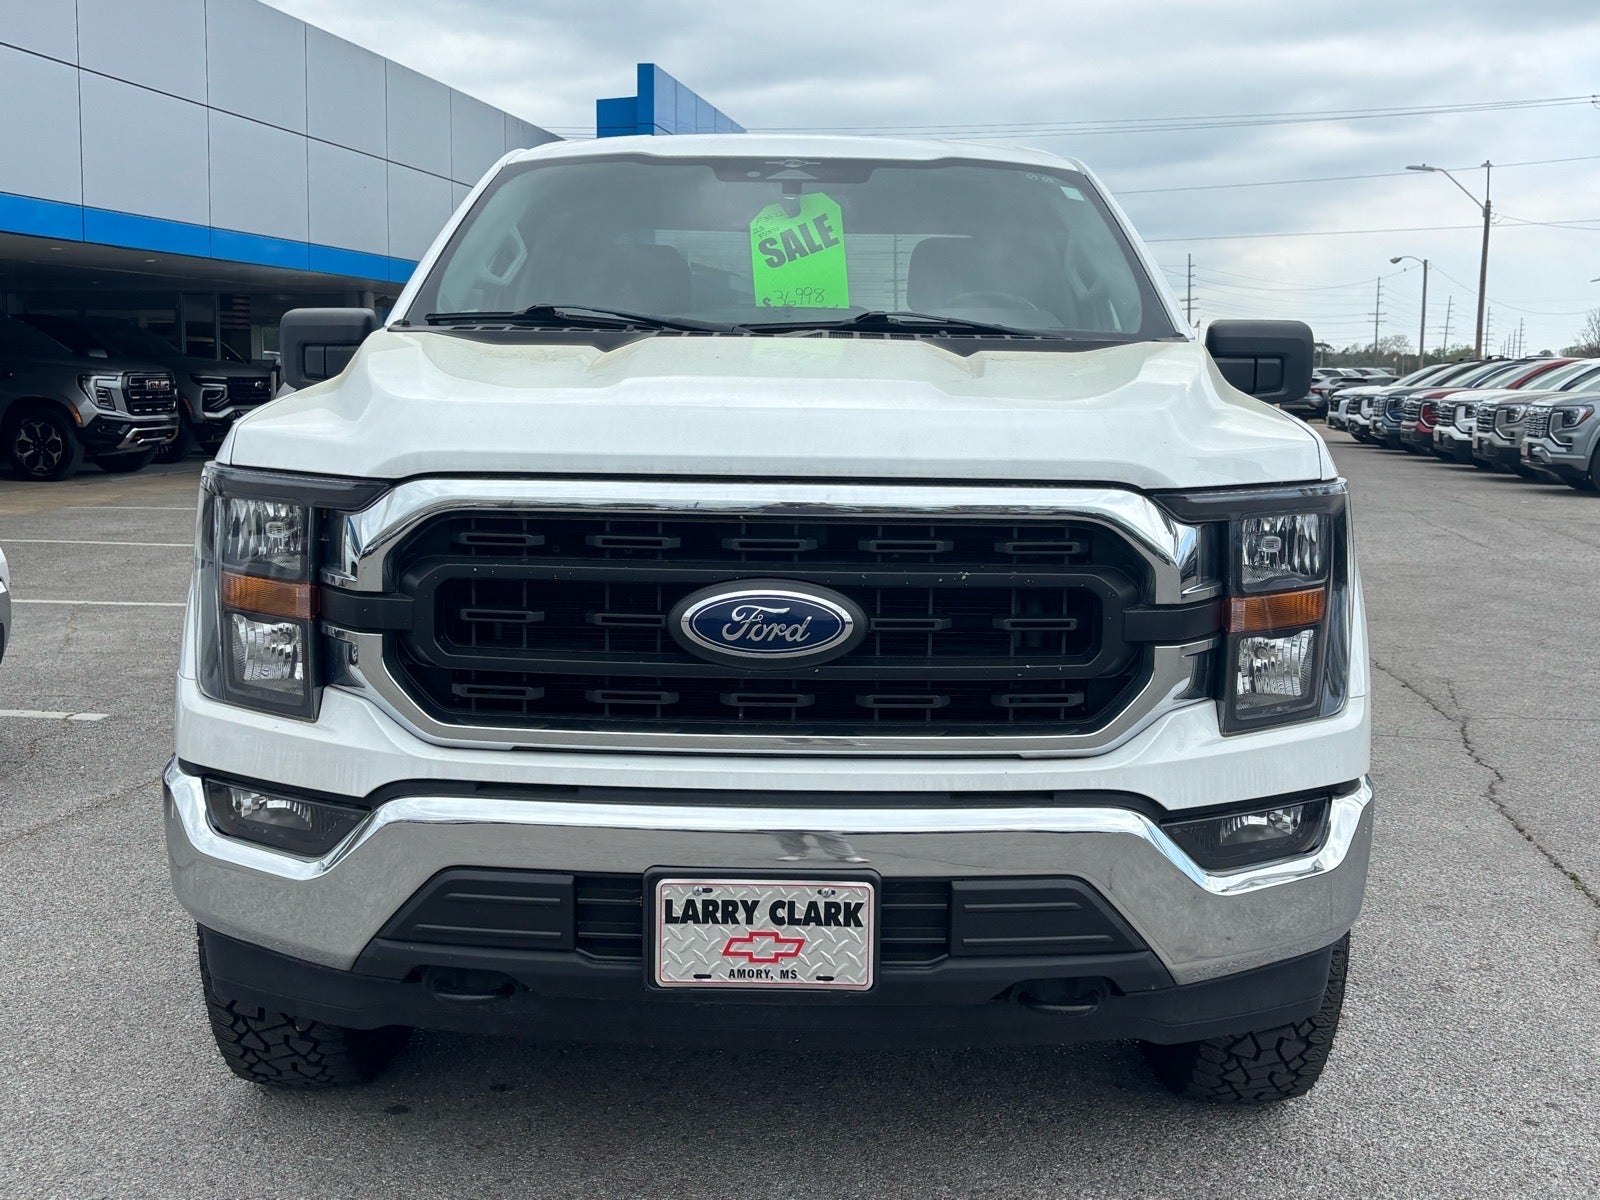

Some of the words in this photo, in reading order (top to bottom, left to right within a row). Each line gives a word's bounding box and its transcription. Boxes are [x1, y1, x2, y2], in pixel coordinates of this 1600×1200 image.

[758, 213, 840, 268] SALE
[722, 605, 813, 642] Ford
[664, 899, 760, 925] LARRY
[769, 900, 864, 928] CLARK
[728, 969, 774, 981] AMORY,
[780, 969, 798, 980] MS
